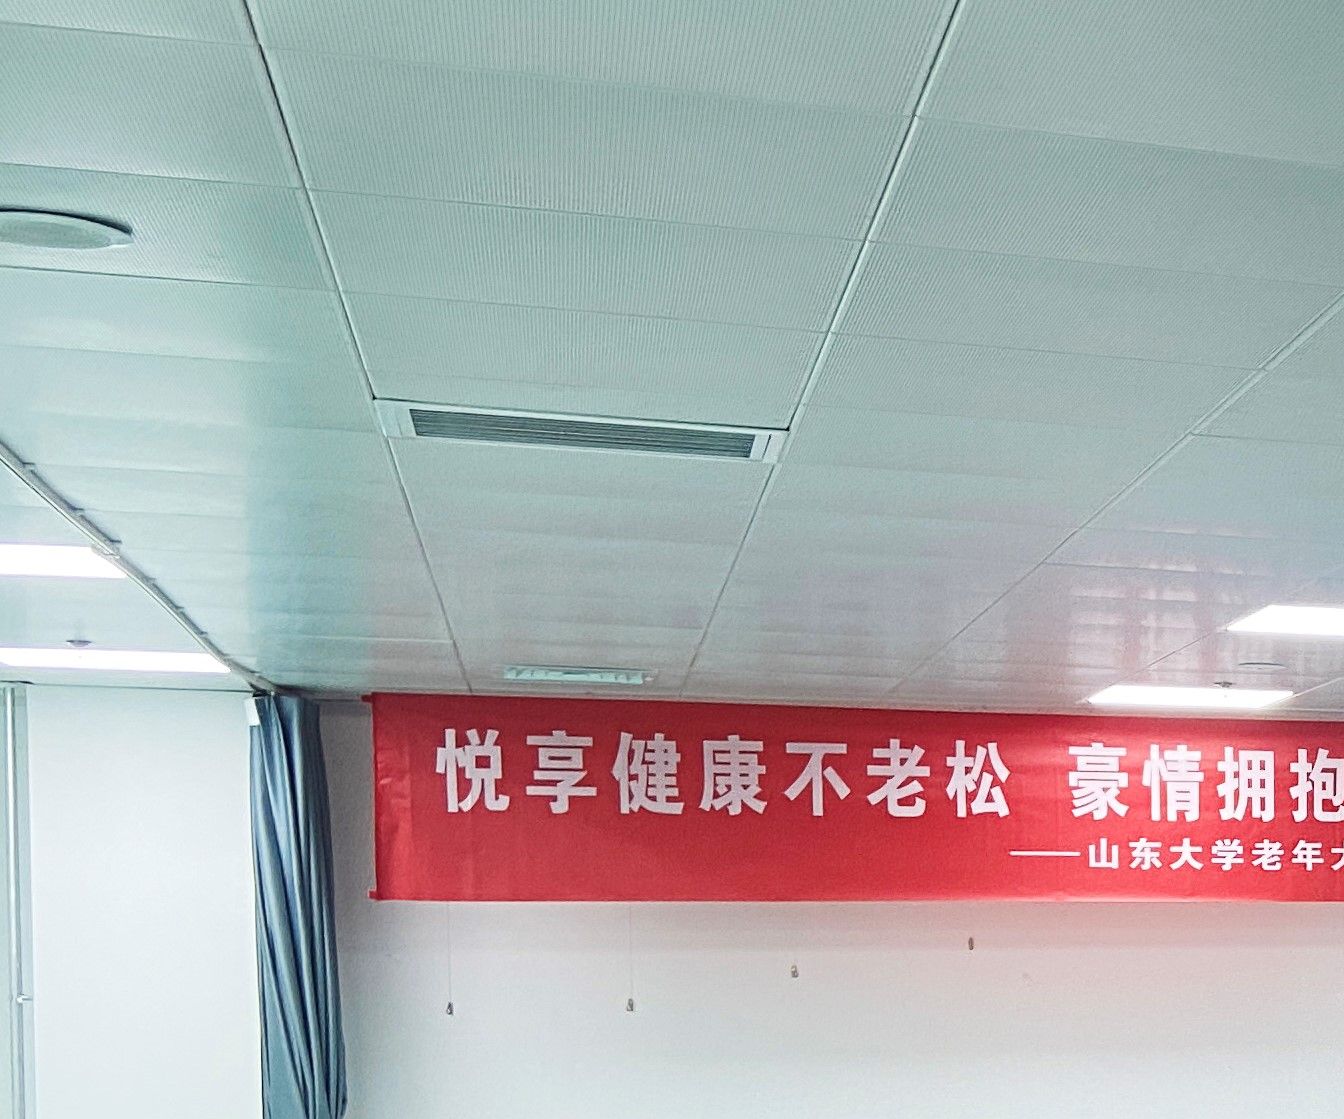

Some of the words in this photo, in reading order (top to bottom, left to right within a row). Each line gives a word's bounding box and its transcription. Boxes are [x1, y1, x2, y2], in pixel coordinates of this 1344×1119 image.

[435, 728, 1011, 818] 悦享健康不老松
